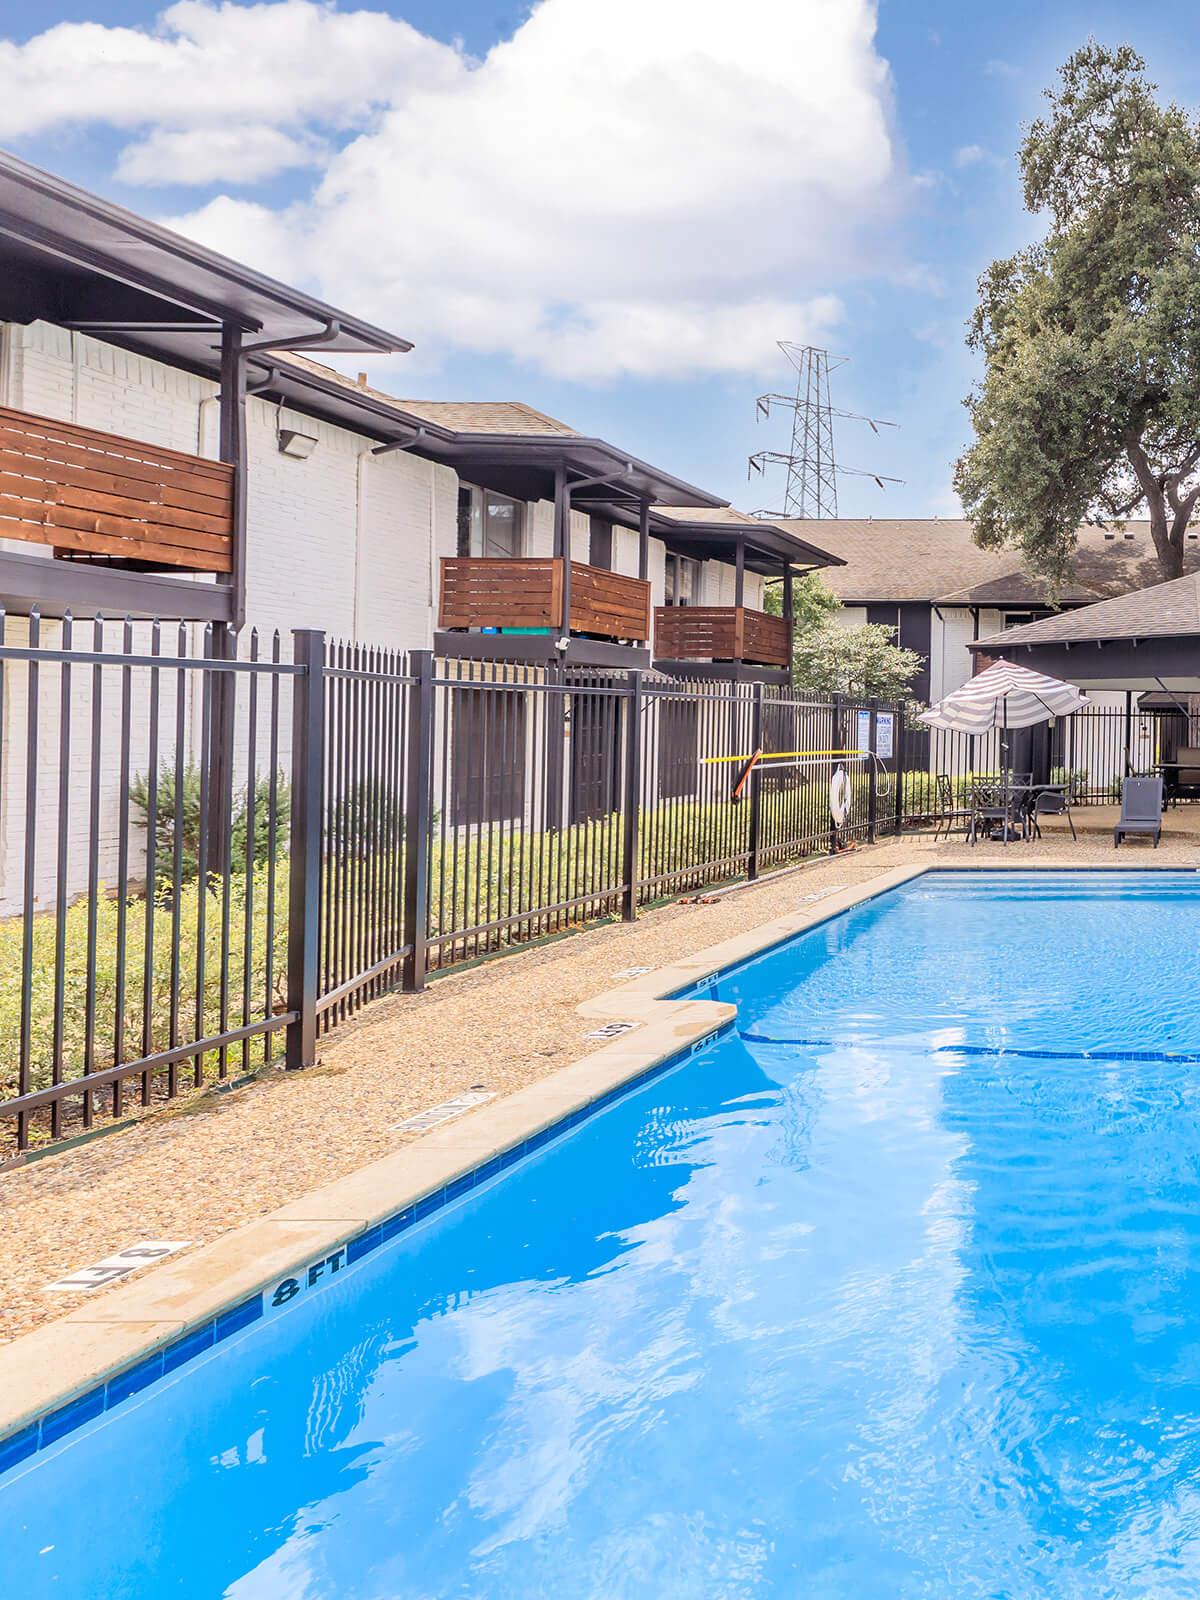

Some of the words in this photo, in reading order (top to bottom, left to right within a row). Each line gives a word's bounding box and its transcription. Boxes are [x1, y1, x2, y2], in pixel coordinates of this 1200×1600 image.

[693, 1041, 704, 1052] 6
[704, 1032, 719, 1045] FT
[119, 1247, 171, 1258] 8
[56, 1265, 136, 1289] FT
[271, 1277, 300, 1308] 8
